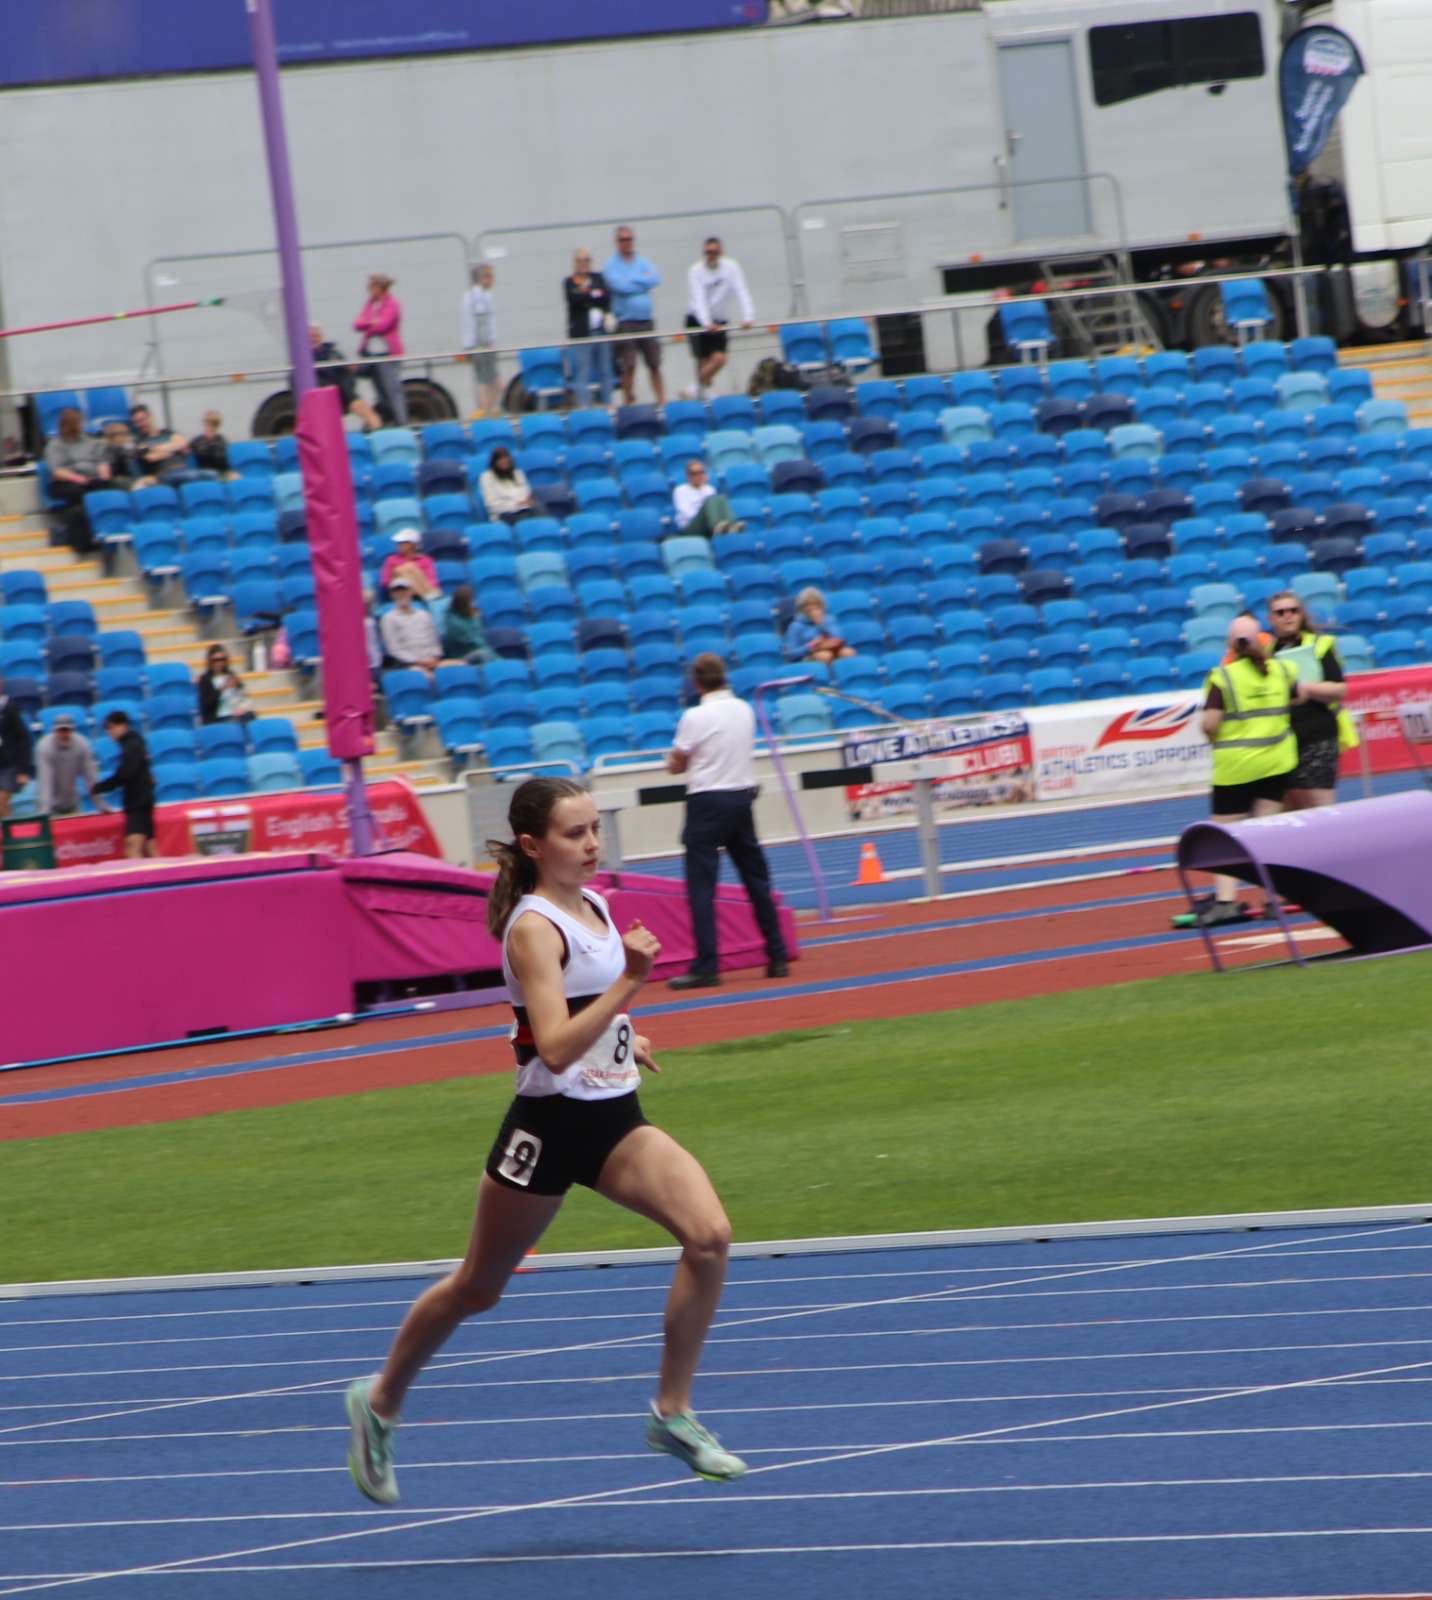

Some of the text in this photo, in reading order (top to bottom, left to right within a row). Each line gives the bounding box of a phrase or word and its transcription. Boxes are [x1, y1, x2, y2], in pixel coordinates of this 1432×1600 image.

[845, 737, 903, 768] LOVE
[1041, 743, 1211, 776] ATHLETICS SUPPORT
[265, 811, 335, 839] English
[614, 1024, 630, 1065] 8
[512, 1140, 537, 1179] 9
